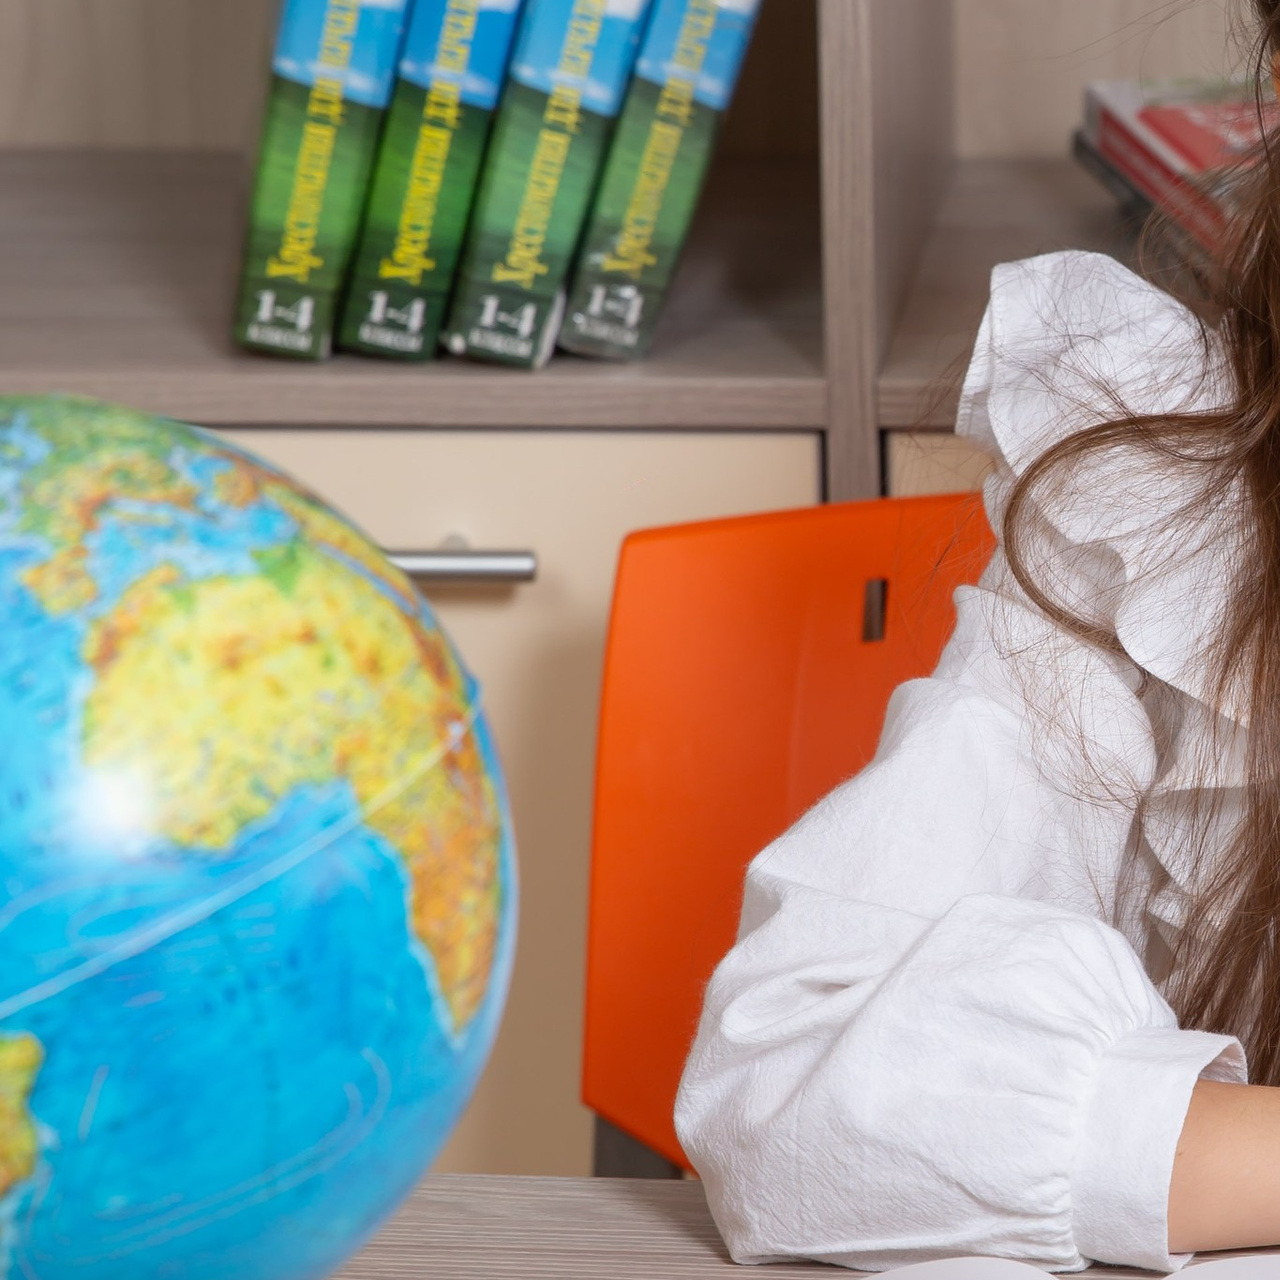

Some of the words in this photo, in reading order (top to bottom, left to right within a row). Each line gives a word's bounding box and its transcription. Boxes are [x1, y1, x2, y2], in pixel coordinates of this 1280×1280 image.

[308, 78, 345, 122] для
[423, 82, 462, 126] для
[257, 290, 315, 332] 1-4
[369, 290, 427, 333] 1-4
[479, 294, 537, 337] 1-4
